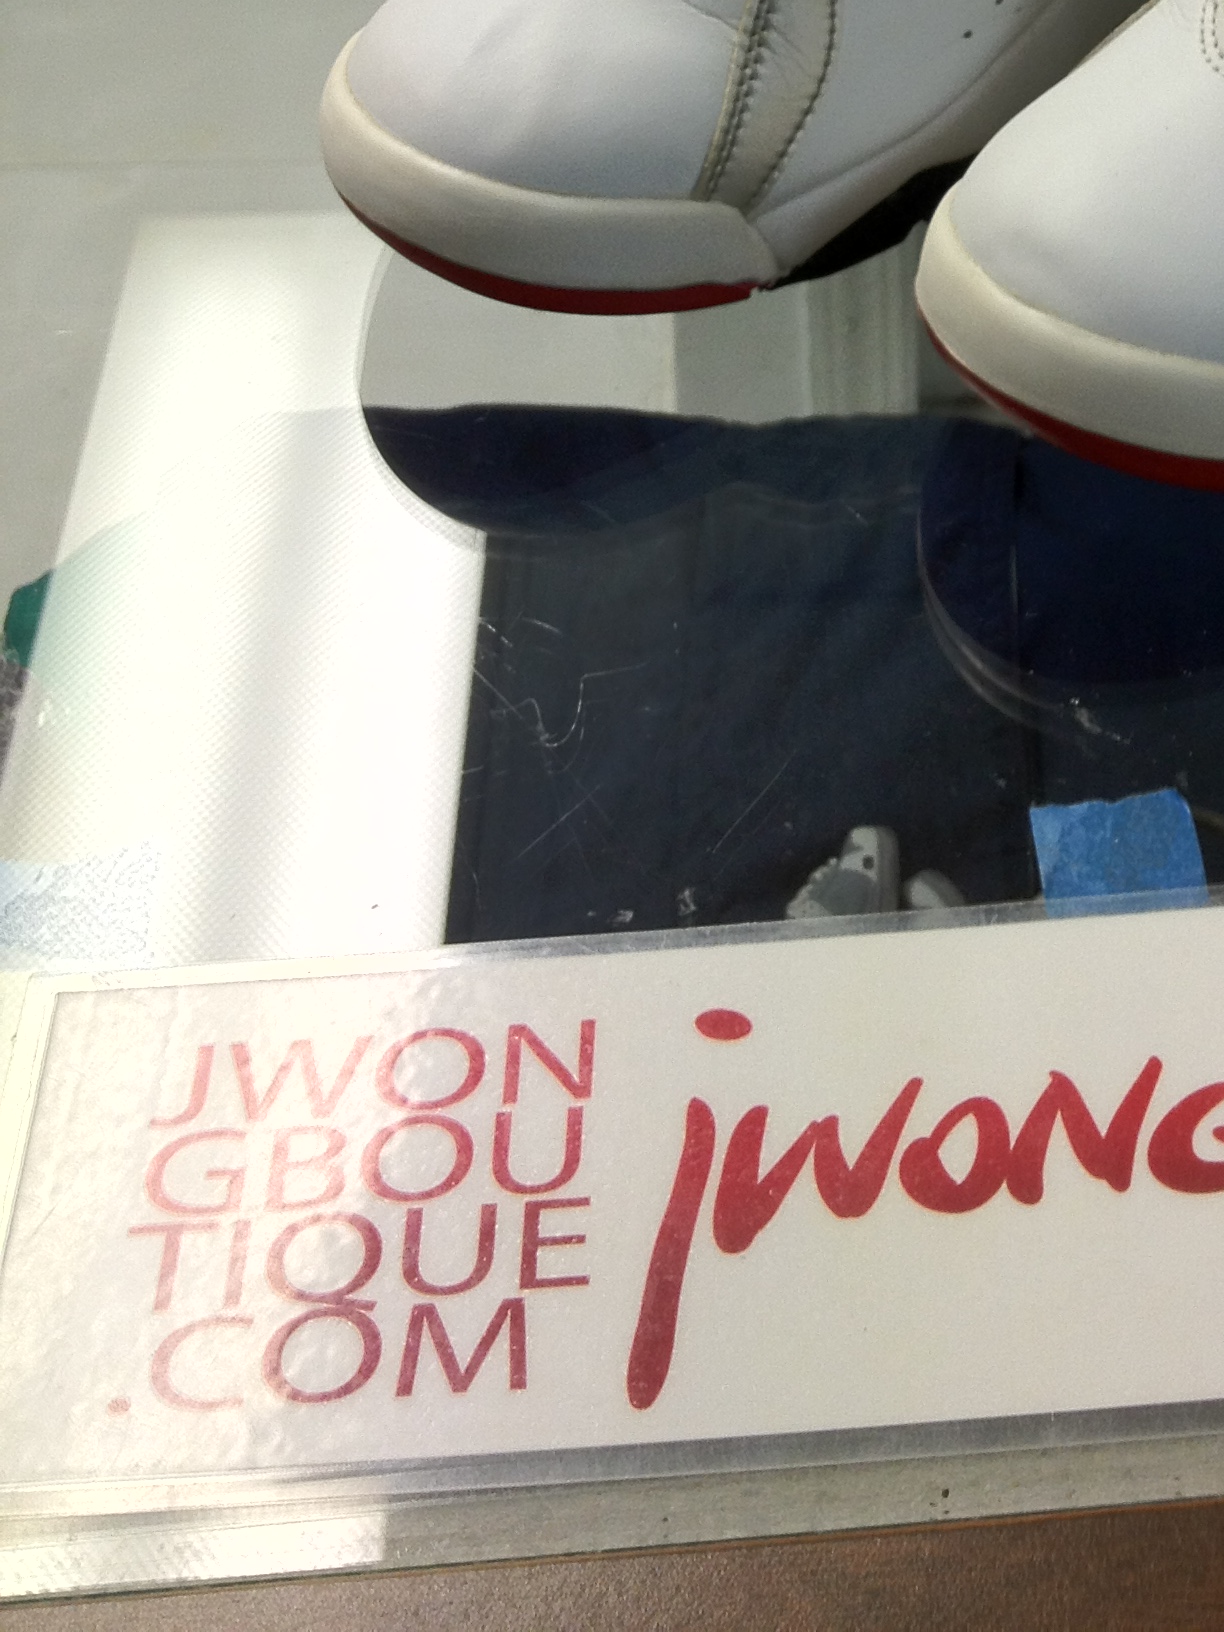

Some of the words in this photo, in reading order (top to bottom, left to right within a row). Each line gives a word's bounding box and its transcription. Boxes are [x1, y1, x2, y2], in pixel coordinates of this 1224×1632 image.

[150, 1018, 596, 1127] JWON
[143, 1106, 585, 1217] GBOU
[127, 1196, 592, 1313] TIQUE
[106, 1297, 528, 1415] .COM
